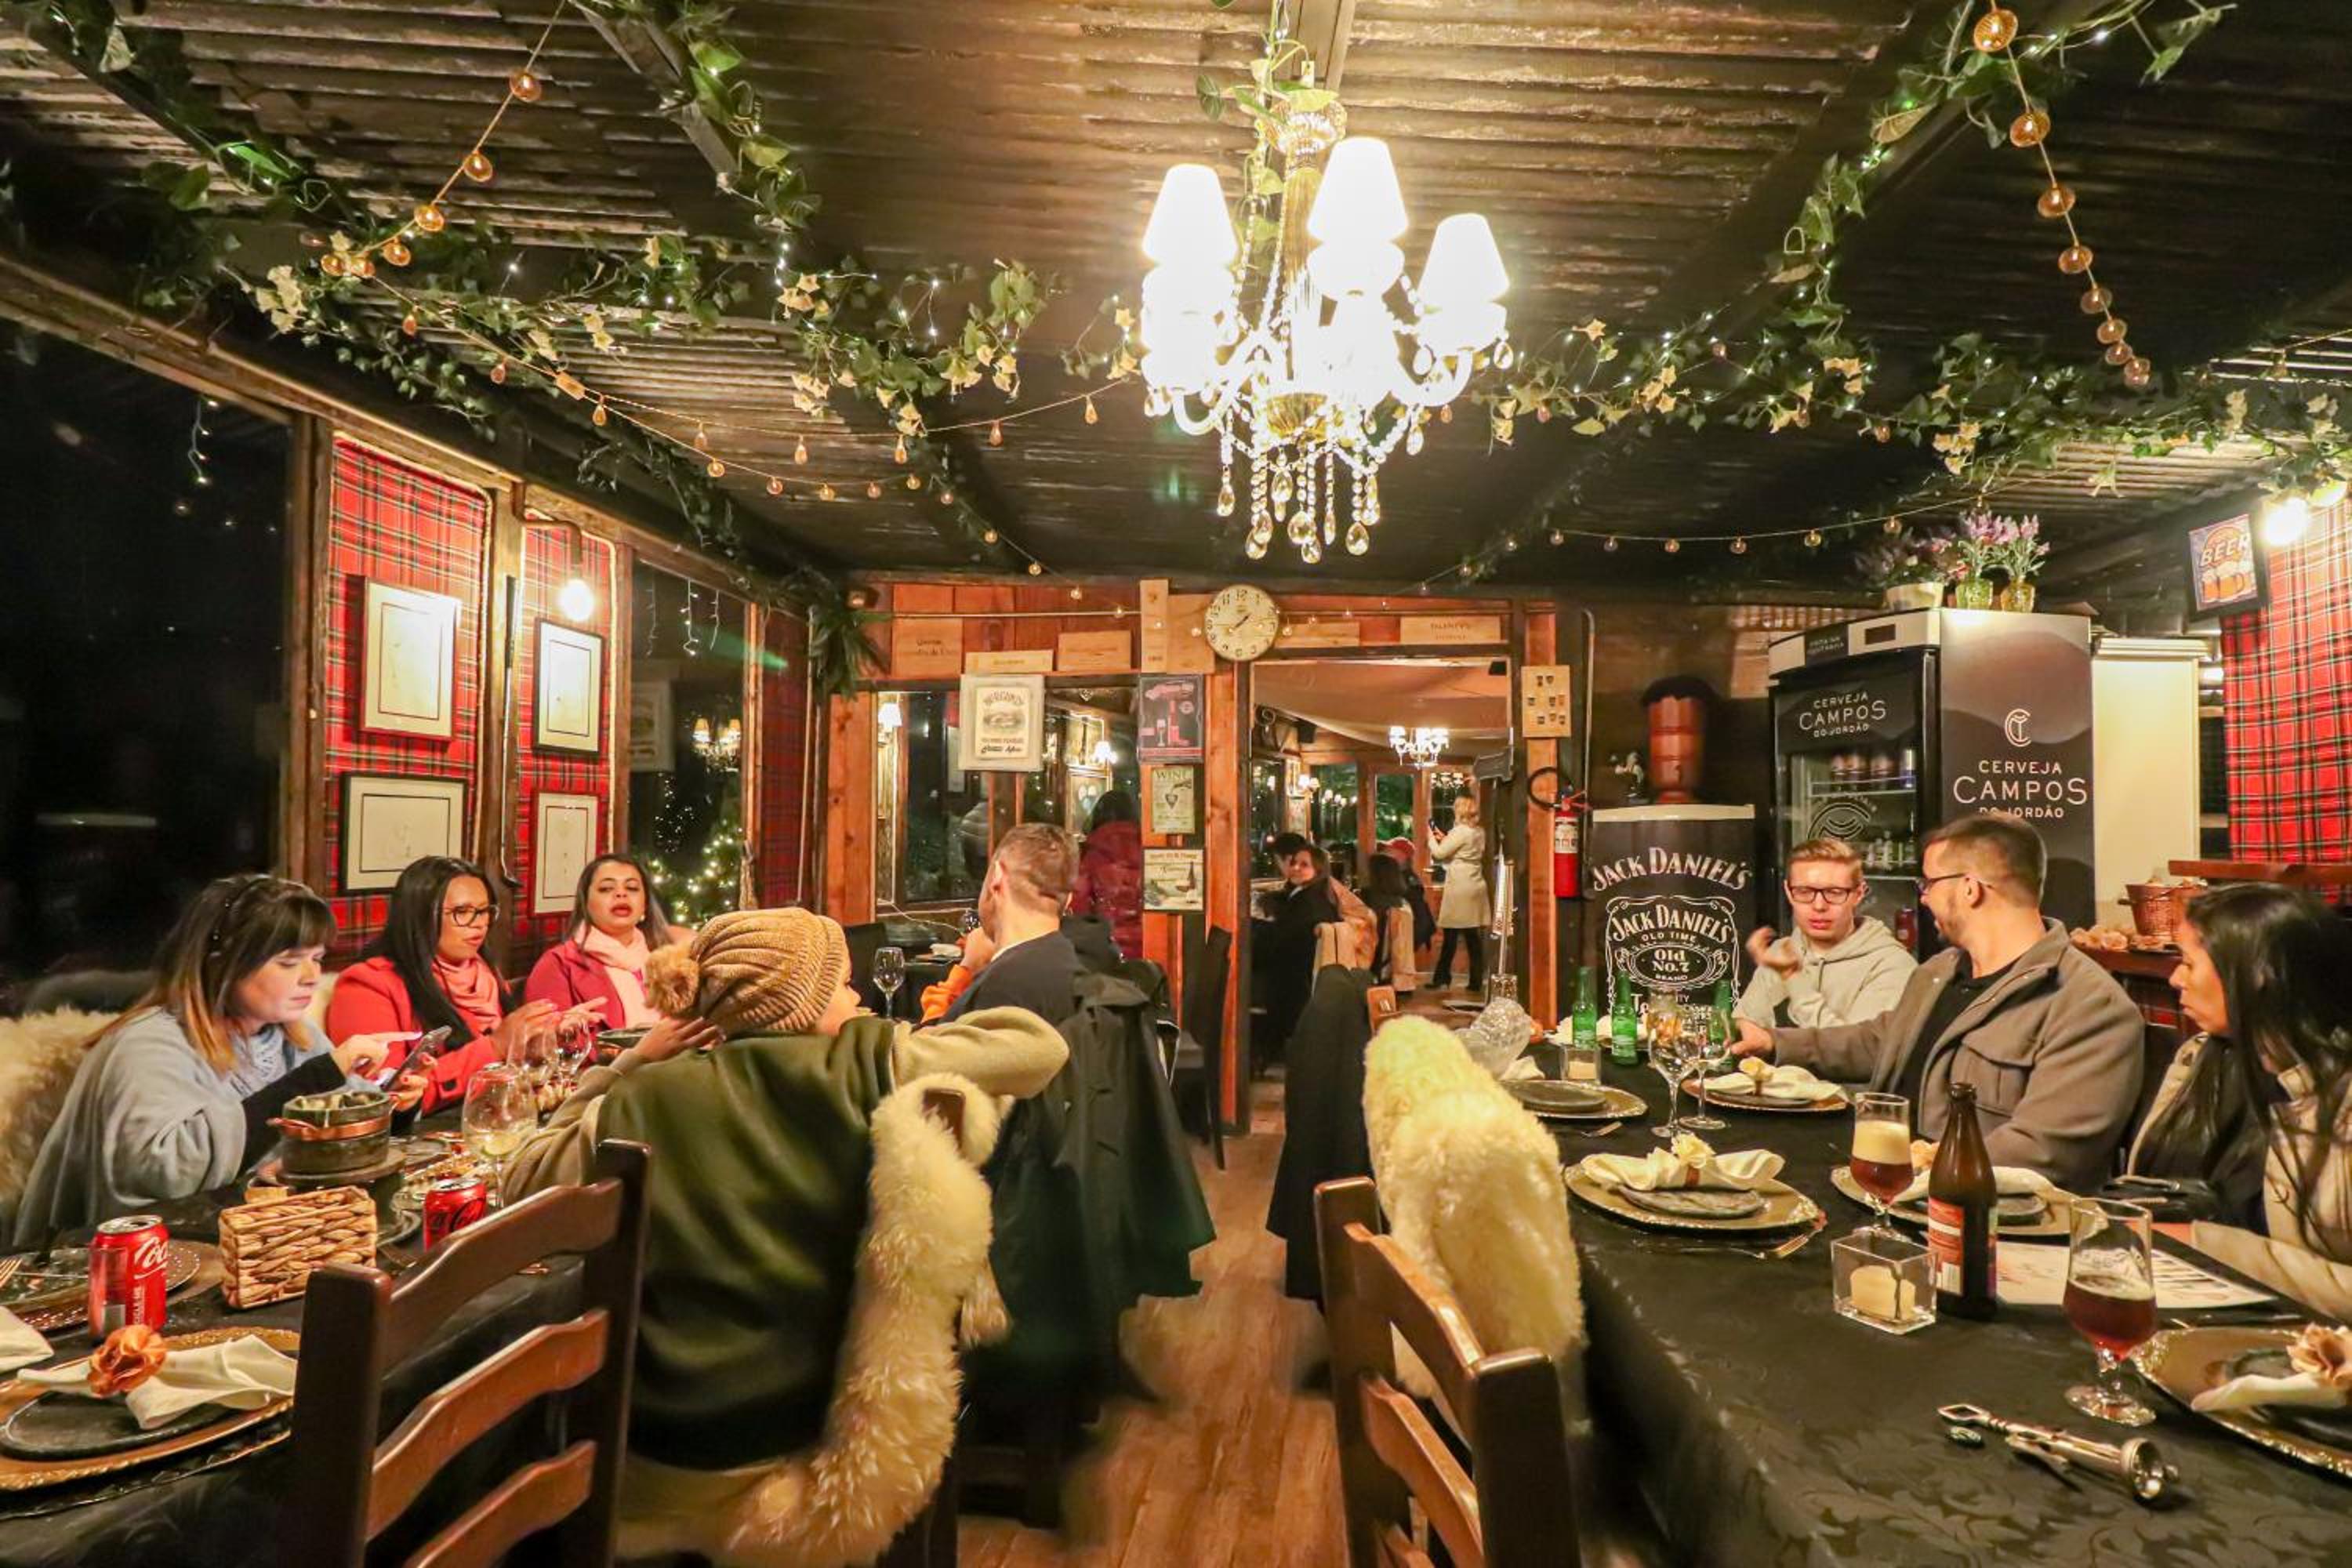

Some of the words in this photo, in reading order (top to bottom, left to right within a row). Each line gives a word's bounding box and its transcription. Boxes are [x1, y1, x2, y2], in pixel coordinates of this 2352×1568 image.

[2199, 535, 2249, 568] BEER
[1236, 589, 1248, 601] 12
[1813, 691, 1869, 710] CERVEJA
[1798, 700, 1887, 731] CAMPOS
[1978, 760, 2063, 775] CERVEJA
[1953, 775, 2088, 805] CAMPOS
[1593, 856, 1647, 892] JACK
[1649, 847, 1753, 891] DANIEL'S
[1610, 911, 1656, 942] JACK
[1655, 904, 1732, 944] DANIEL'S
[1641, 933, 1665, 942] OLD
[1669, 931, 1697, 943] TIME
[1653, 948, 1686, 962] Old
